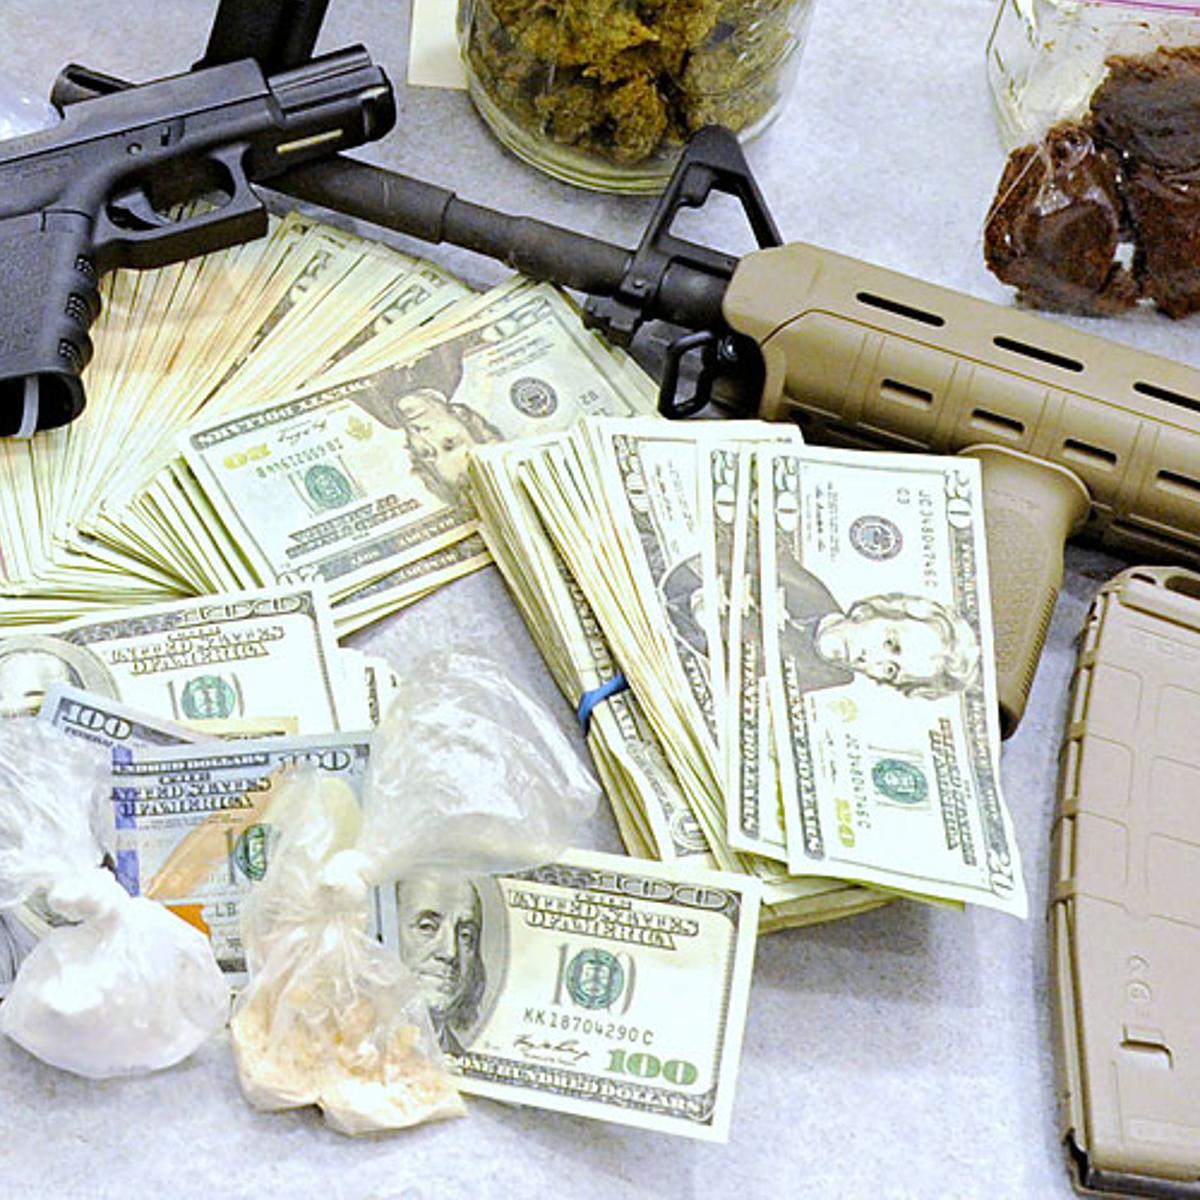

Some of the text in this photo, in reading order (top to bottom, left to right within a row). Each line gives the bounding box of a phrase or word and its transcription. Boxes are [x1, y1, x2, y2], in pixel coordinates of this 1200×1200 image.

[710, 449, 740, 525] 20
[772, 455, 800, 532] 20
[943, 468, 973, 530] 20
[179, 595, 302, 624] 100
[109, 626, 286, 665] UNITED STATES
[62, 701, 133, 740] 100
[187, 751, 270, 771] DOLLARS
[152, 794, 254, 816] AMERICA
[185, 777, 272, 799] STATES
[594, 871, 731, 912] 100
[508, 889, 700, 937] UNITED STATES
[556, 916, 678, 951] AMERICA
[604, 1048, 699, 1086] 100
[498, 1062, 599, 1096] HUNDRED
[600, 1081, 704, 1114] DOLLARS
